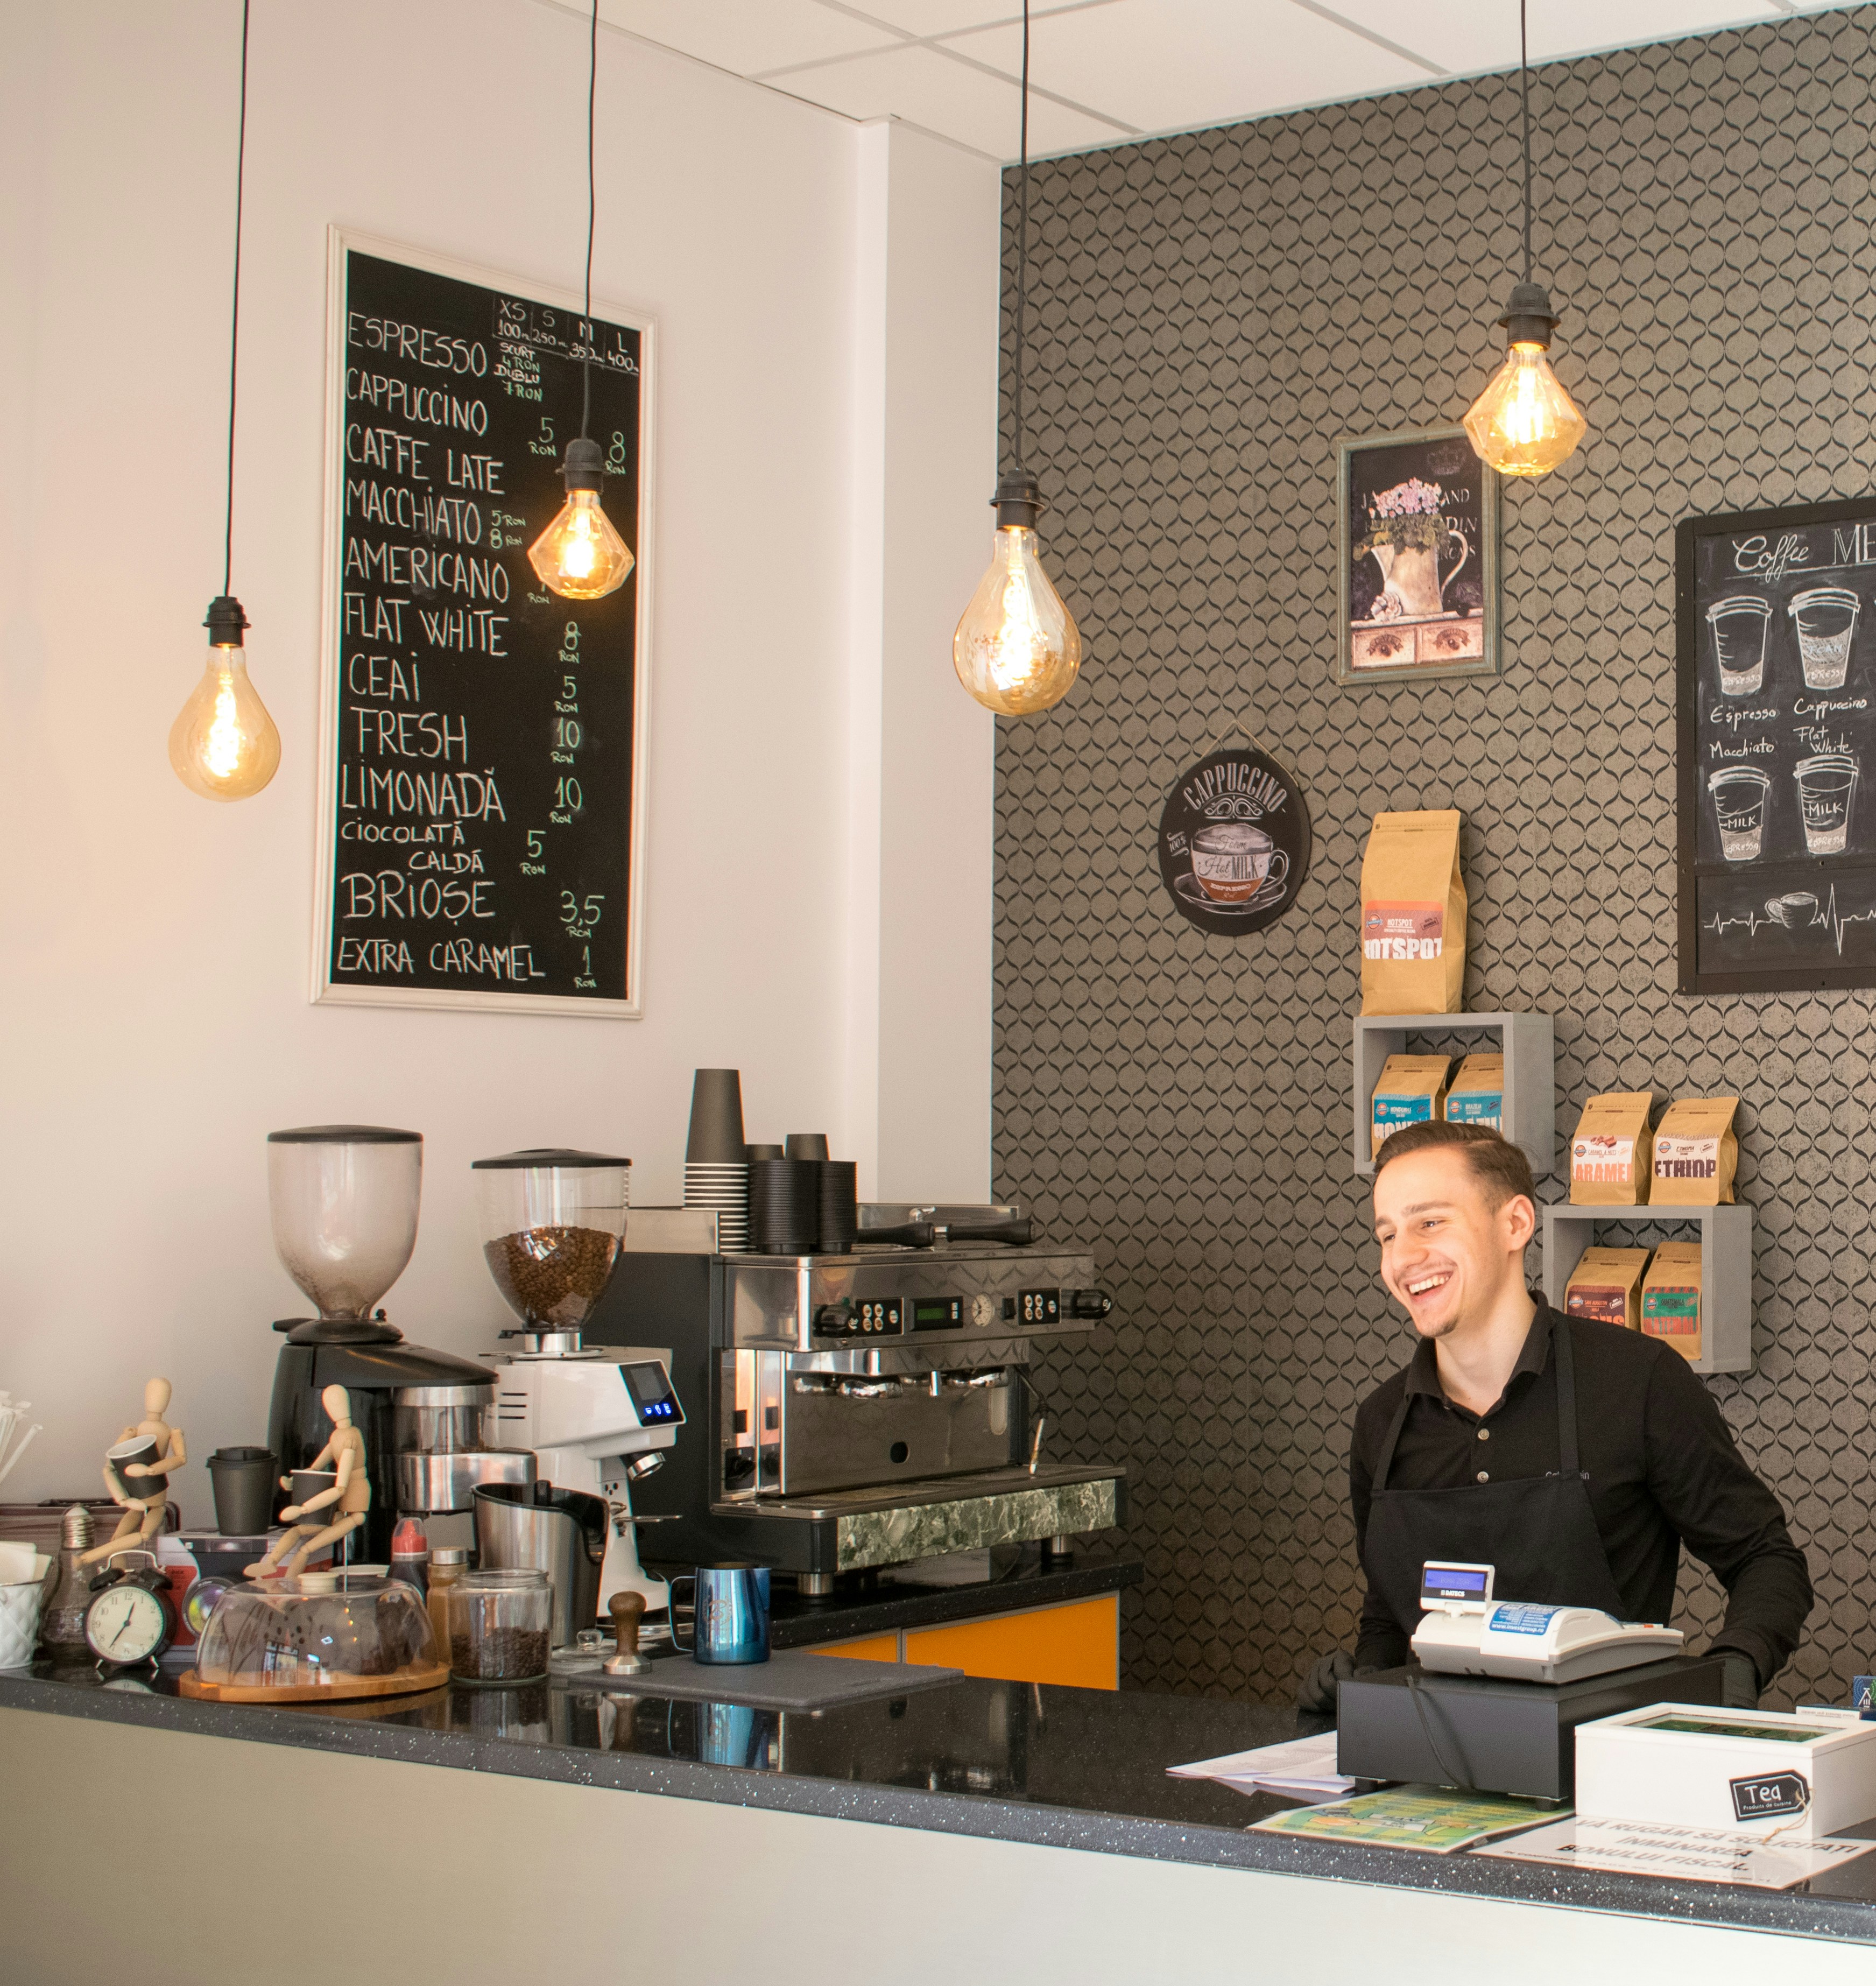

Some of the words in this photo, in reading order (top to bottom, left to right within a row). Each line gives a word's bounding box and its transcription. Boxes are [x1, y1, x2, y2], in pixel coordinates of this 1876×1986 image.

[500, 299, 526, 321] XS
[542, 310, 555, 327] S
[617, 332, 628, 353] L
[347, 312, 487, 377] ESPRESSO
[500, 342, 536, 362] SCURT
[494, 364, 540, 384] DUBLU
[512, 356, 540, 373] RON
[514, 384, 543, 402] RON
[539, 417, 554, 443] 5
[528, 441, 557, 457] RON
[609, 431, 626, 463] 8
[347, 424, 430, 480] CAFFE
[447, 448, 505, 495] LATE
[491, 510, 502, 526] 5
[502, 515, 526, 526] RON
[490, 528, 503, 549] 8
[1732, 534, 1809, 583] Coffee
[527, 592, 550, 603] RON
[344, 592, 411, 644] FLAT
[563, 621, 582, 651] 8
[558, 650, 580, 664] RON
[562, 675, 576, 699] 5
[554, 701, 579, 713] RON
[1794, 697, 1867, 721] Cappuccino
[1710, 705, 1777, 732] Espresso
[350, 706, 468, 764] FRESH
[556, 717, 581, 749] 10
[1793, 726, 1829, 742] Flat
[1810, 733, 1853, 753] White
[549, 752, 574, 764] RON
[1709, 736, 1774, 759] Macchiato
[554, 777, 582, 808] 10
[1183, 762, 1287, 813] CAPPUCCINO
[549, 811, 572, 824] RON
[1808, 802, 1844, 818] MILK
[1727, 815, 1757, 829] MILK
[526, 830, 546, 858] 5
[519, 862, 546, 875] RON
[1231, 855, 1259, 879] MILK
[559, 890, 605, 926] 3,5
[1387, 918, 1413, 926] HOTSPOT
[337, 936, 414, 974] EXTRA
[430, 938, 546, 981] CARAMEL
[582, 945, 591, 976] 1
[574, 976, 597, 988] RON
[1744, 1784, 1781, 1804] Tea
[1556, 1844, 1666, 1861] BONULUI
